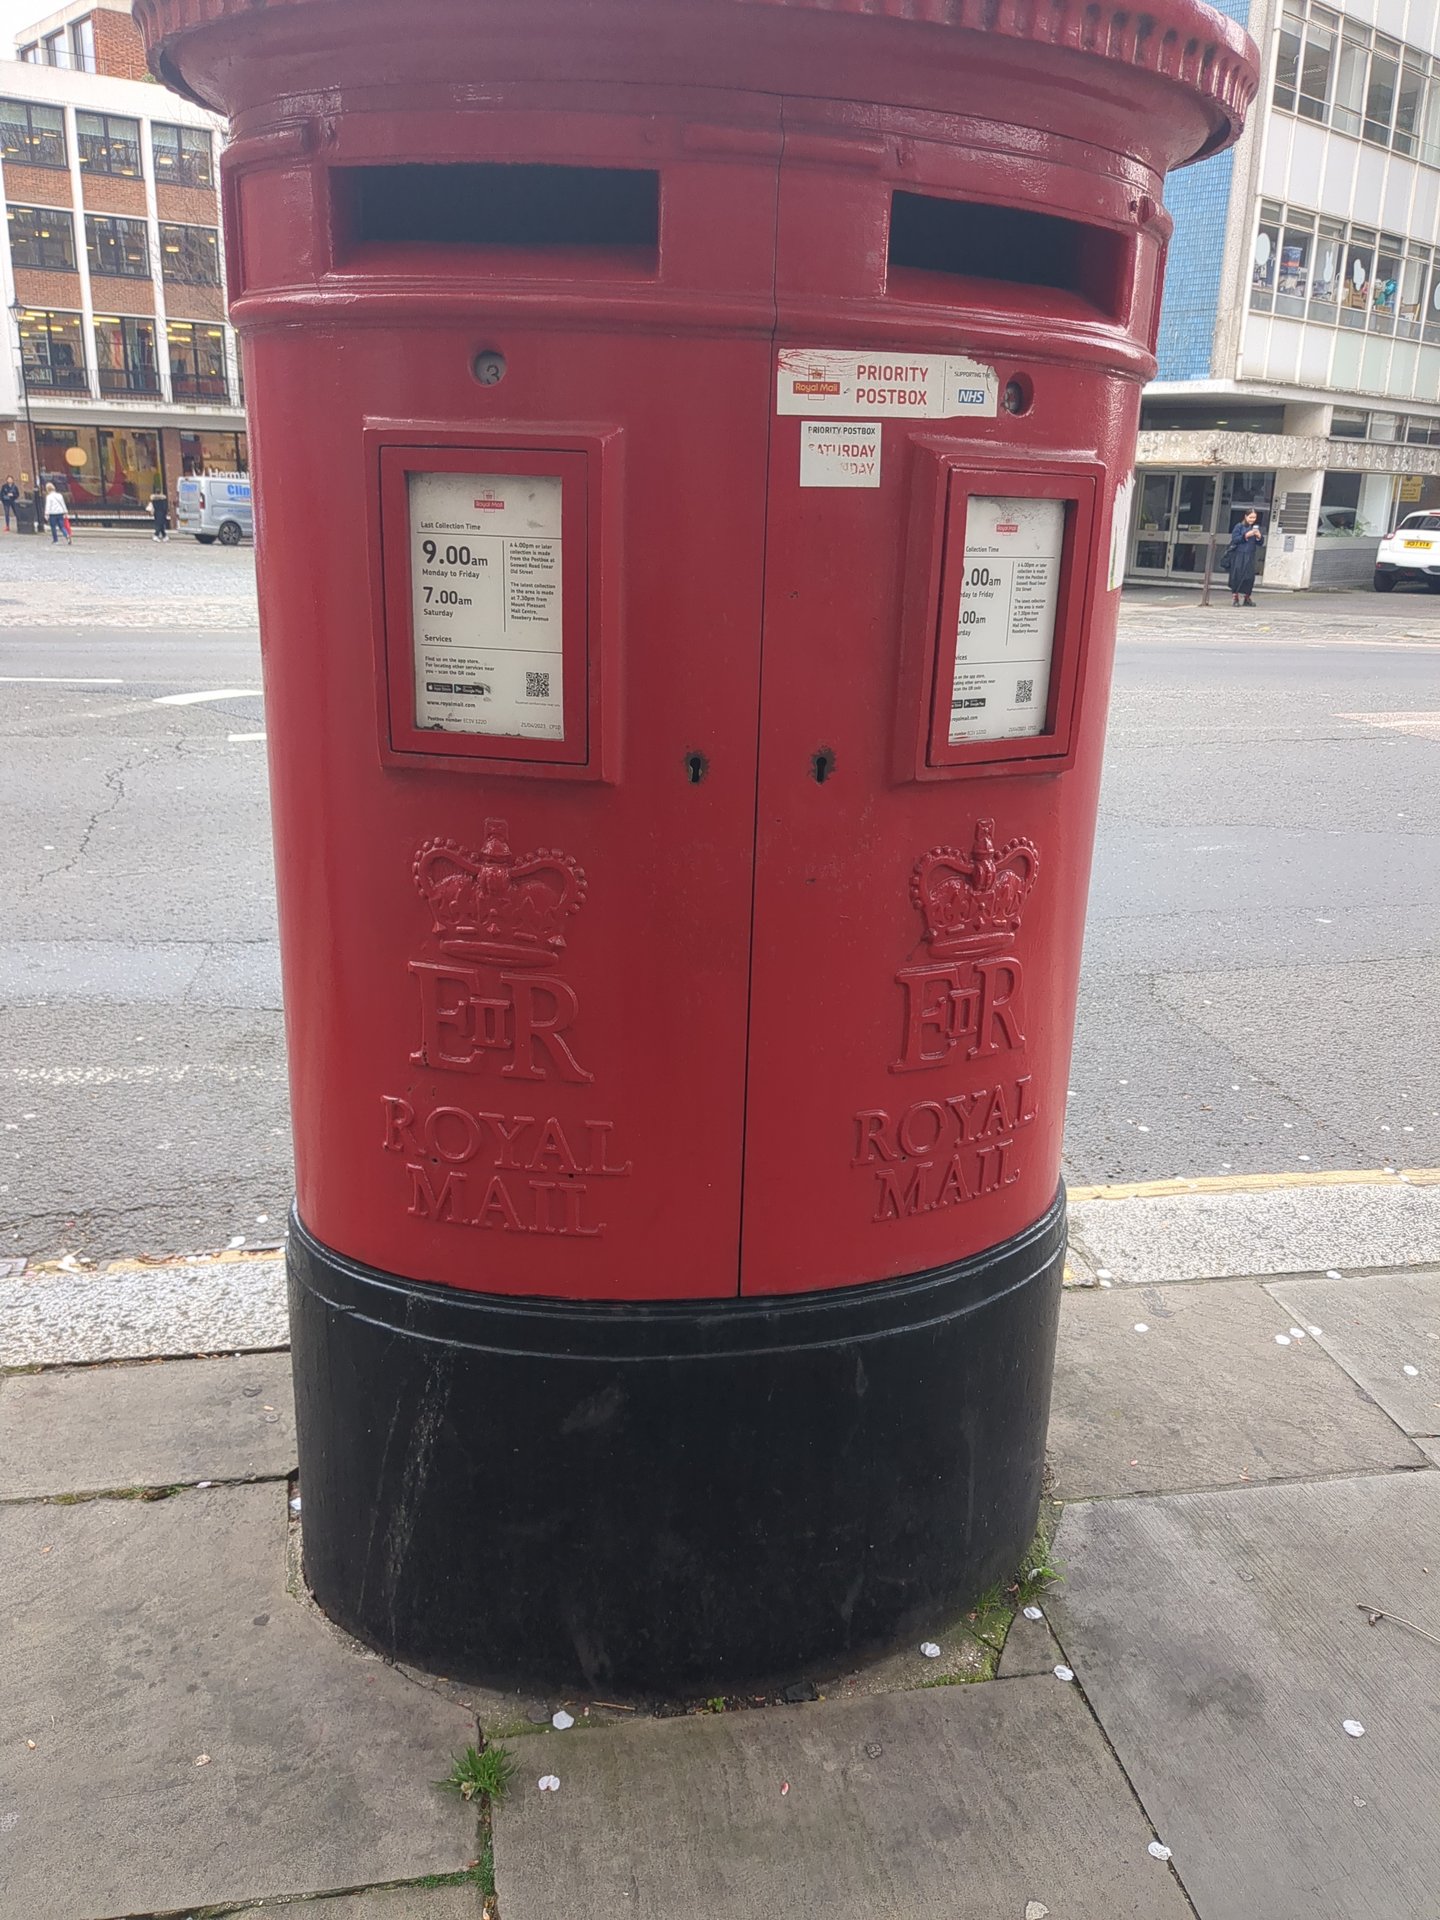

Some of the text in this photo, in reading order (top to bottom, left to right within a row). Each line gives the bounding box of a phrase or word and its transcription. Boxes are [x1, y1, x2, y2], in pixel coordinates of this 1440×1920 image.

[856, 364, 929, 383] PRIORITY
[795, 382, 838, 393] Royal Mail
[855, 387, 928, 406] POSTBOX
[959, 390, 984, 403] NHS
[808, 426, 876, 435] PRIORITY POSTBOX
[475, 501, 504, 509] Royal Mail
[420, 521, 434, 529] Last
[435, 521, 465, 530] Collection
[422, 539, 488, 566] 9.00am
[422, 568, 448, 578] Monday
[459, 570, 480, 579] Friday
[965, 568, 1001, 586] .00am
[423, 586, 472, 606] 7.00am
[978, 590, 994, 598] Friday
[423, 608, 454, 618] Saturday
[958, 610, 986, 624] .00am
[424, 634, 452, 643] Services
[427, 700, 476, 708] www.royalmail.com
[851, 1075, 1039, 1168] ROYAL
[381, 1095, 632, 1175] ROYAL
[873, 1139, 1022, 1222] MAIL
[406, 1163, 607, 1237] MAIL
